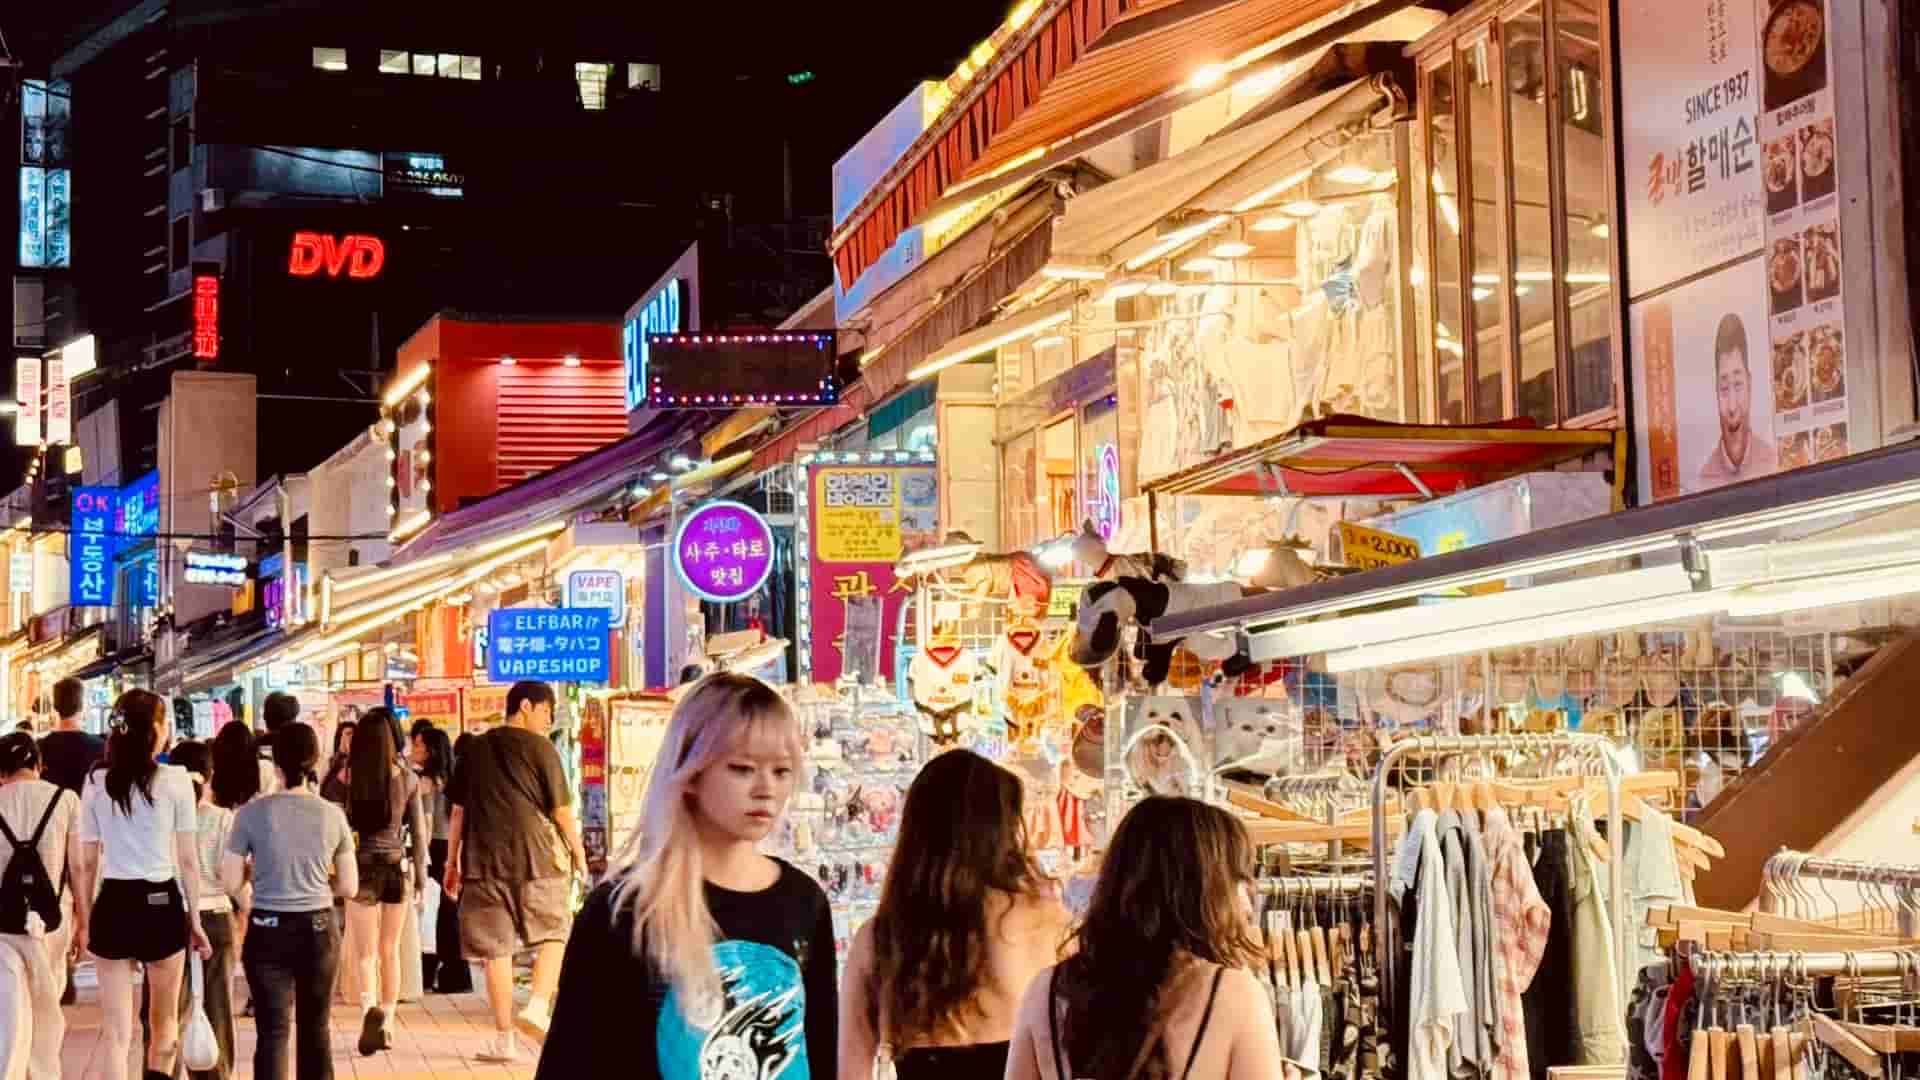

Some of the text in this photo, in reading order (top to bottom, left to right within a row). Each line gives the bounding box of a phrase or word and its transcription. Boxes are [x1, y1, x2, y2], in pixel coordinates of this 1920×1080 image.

[1686, 70, 1749, 124] SINCE 1937
[1687, 116, 1759, 194] 할매순
[289, 232, 384, 278] DVD
[76, 493, 109, 512] OK
[79, 517, 105, 601] 부동산
[577, 575, 614, 589] VAPE
[711, 566, 743, 588] 맛집
[499, 657, 601, 675] VAPESHOP
